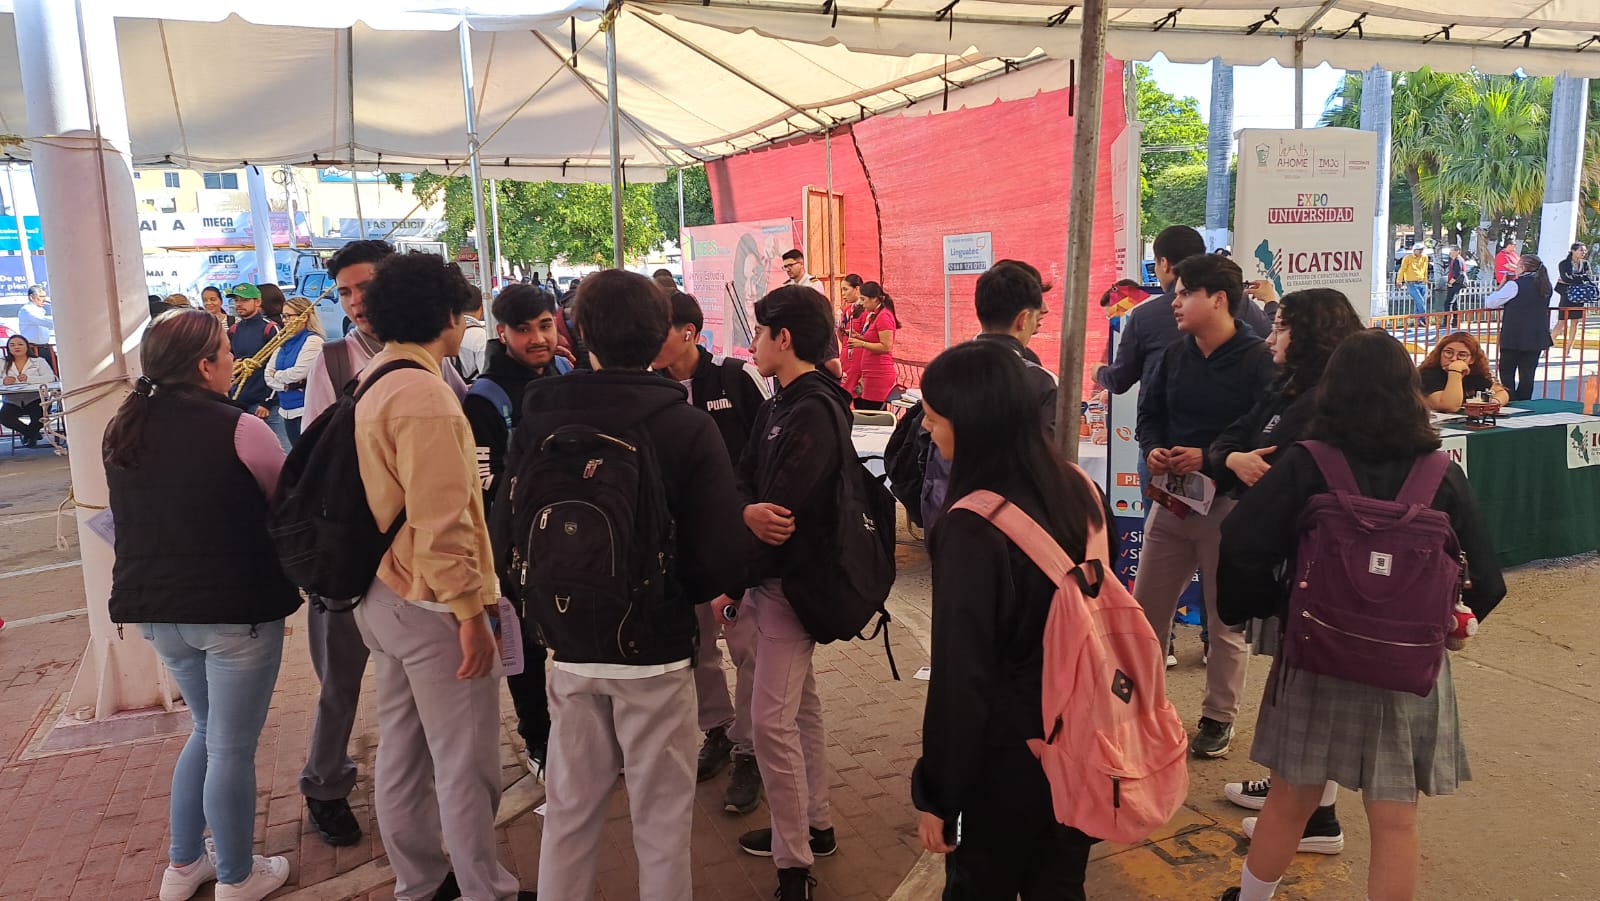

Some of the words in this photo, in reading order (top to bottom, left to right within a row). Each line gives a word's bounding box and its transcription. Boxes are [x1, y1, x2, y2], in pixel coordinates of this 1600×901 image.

[1277, 158, 1309, 168] AHOME
[1297, 193, 1329, 207] EXPO
[1269, 208, 1353, 223] UNIVERSIDAD
[202, 217, 234, 227] MEGA
[367, 221, 386, 229] LAS
[208, 254, 236, 264] MEGA
[1288, 250, 1364, 273] ICATSIN
